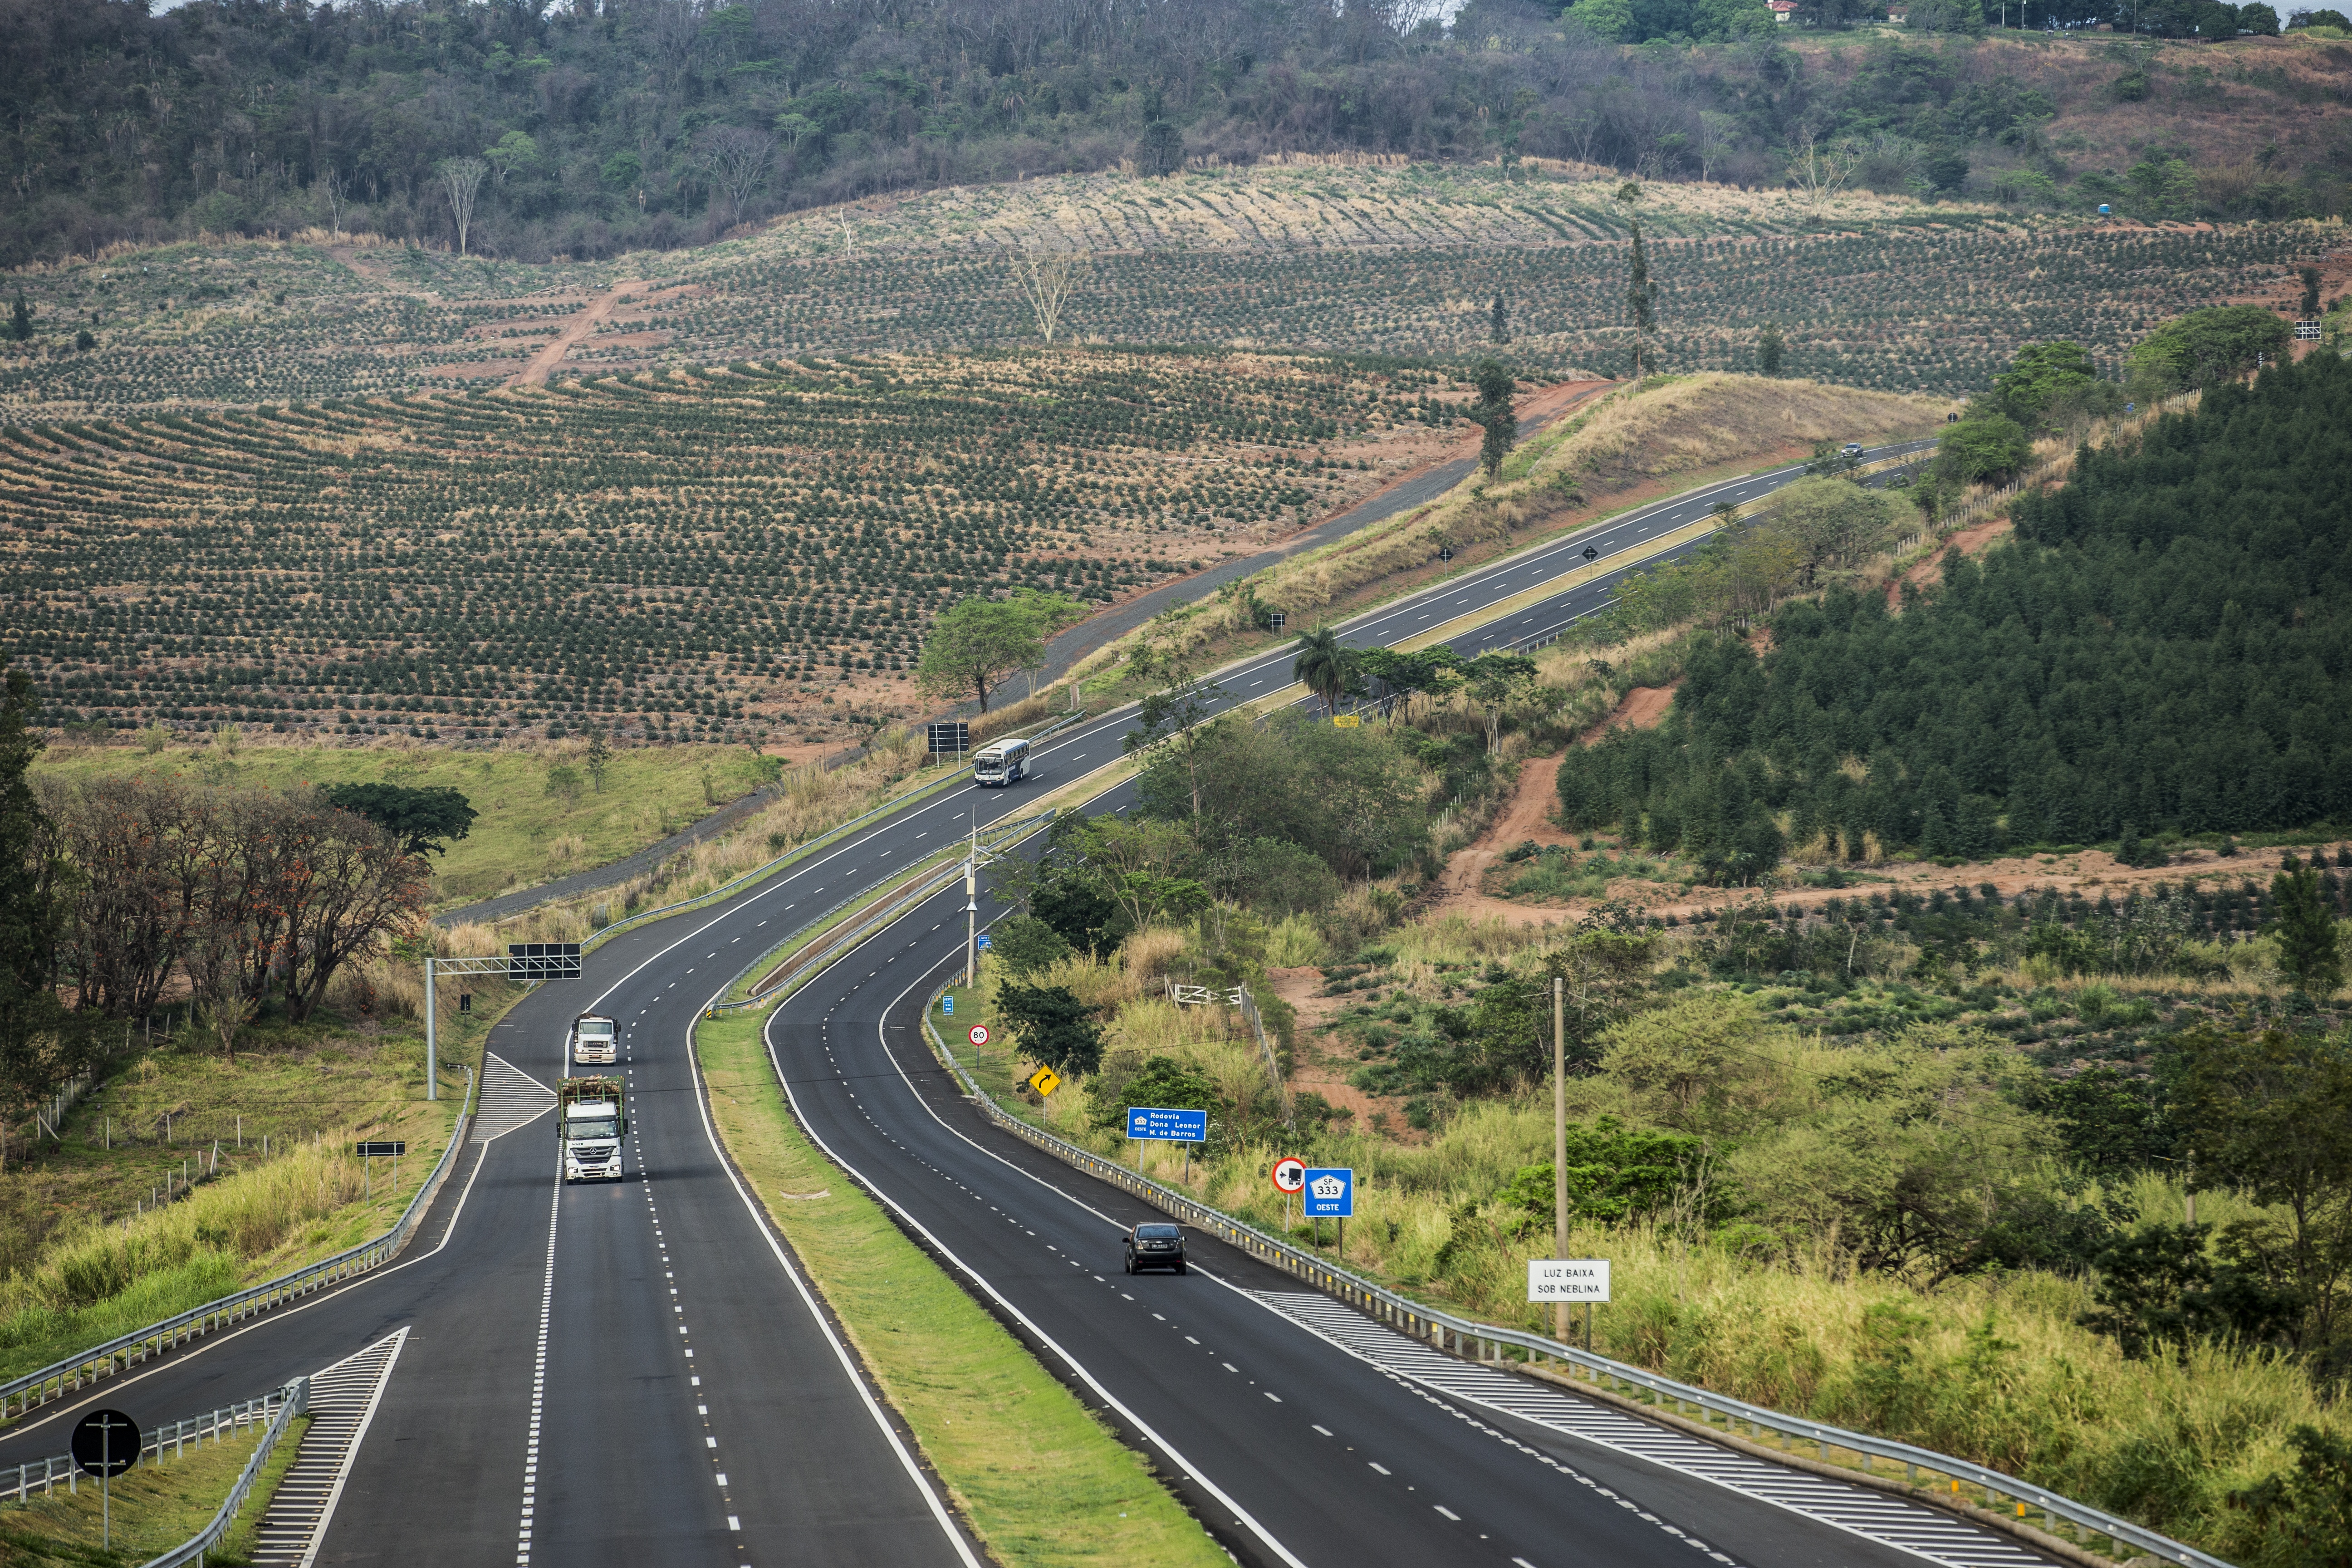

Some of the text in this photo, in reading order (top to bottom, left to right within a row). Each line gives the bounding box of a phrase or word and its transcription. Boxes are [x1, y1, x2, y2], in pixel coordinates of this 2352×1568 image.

[1318, 1186, 1338, 1195] 333
[1544, 1269, 1594, 1278] LUZ BAIXA
[1538, 1285, 1600, 1293] SOB NEBLINA
